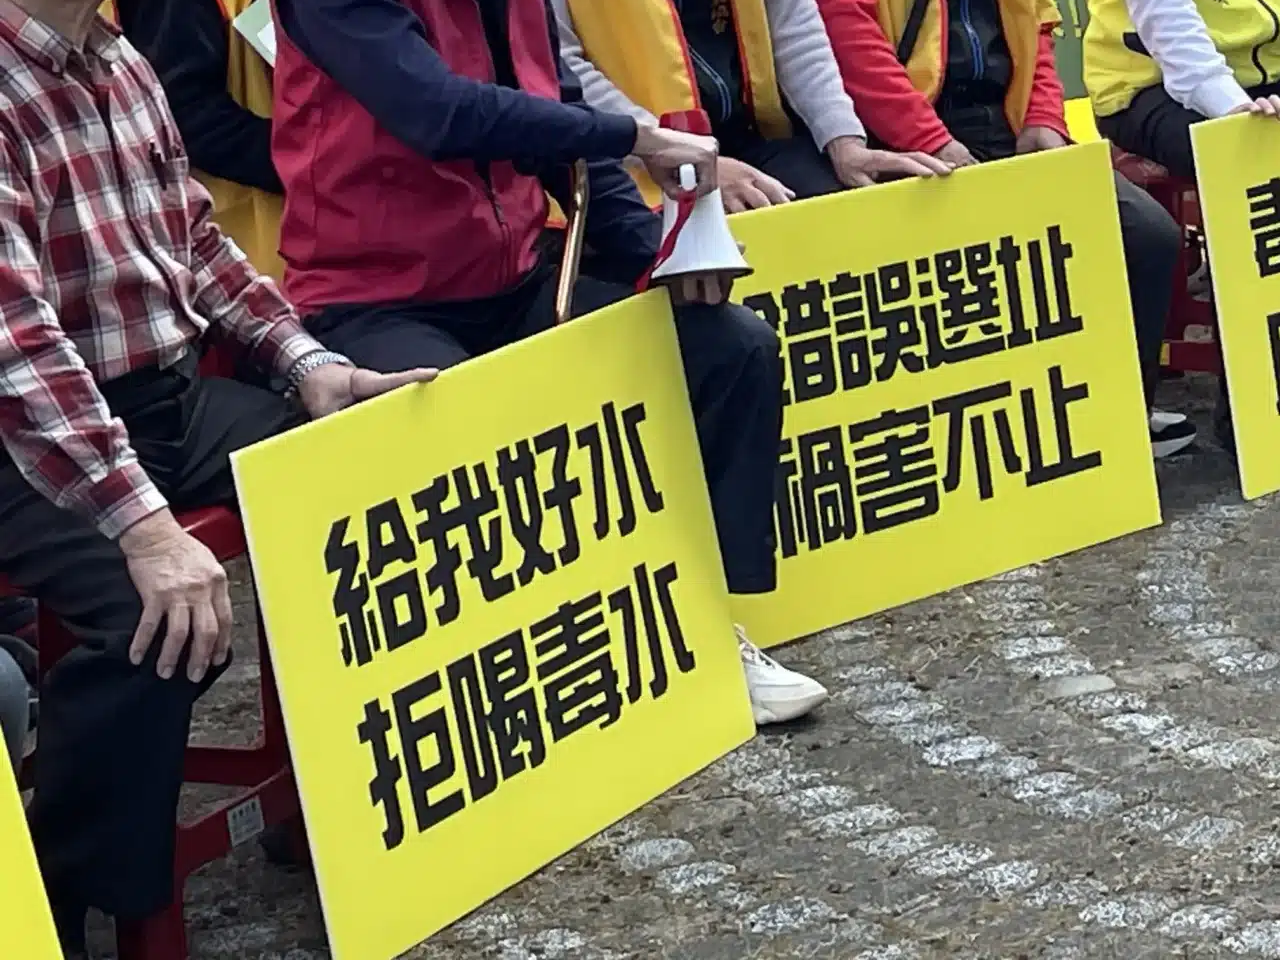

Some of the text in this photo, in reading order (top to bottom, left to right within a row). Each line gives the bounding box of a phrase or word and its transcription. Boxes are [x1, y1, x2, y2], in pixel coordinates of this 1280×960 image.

[742, 225, 1084, 407] 錯誤選址
[323, 400, 664, 669] 給我好水
[774, 364, 1102, 560] 禍害不止
[357, 561, 696, 851] 拒喝毒水
